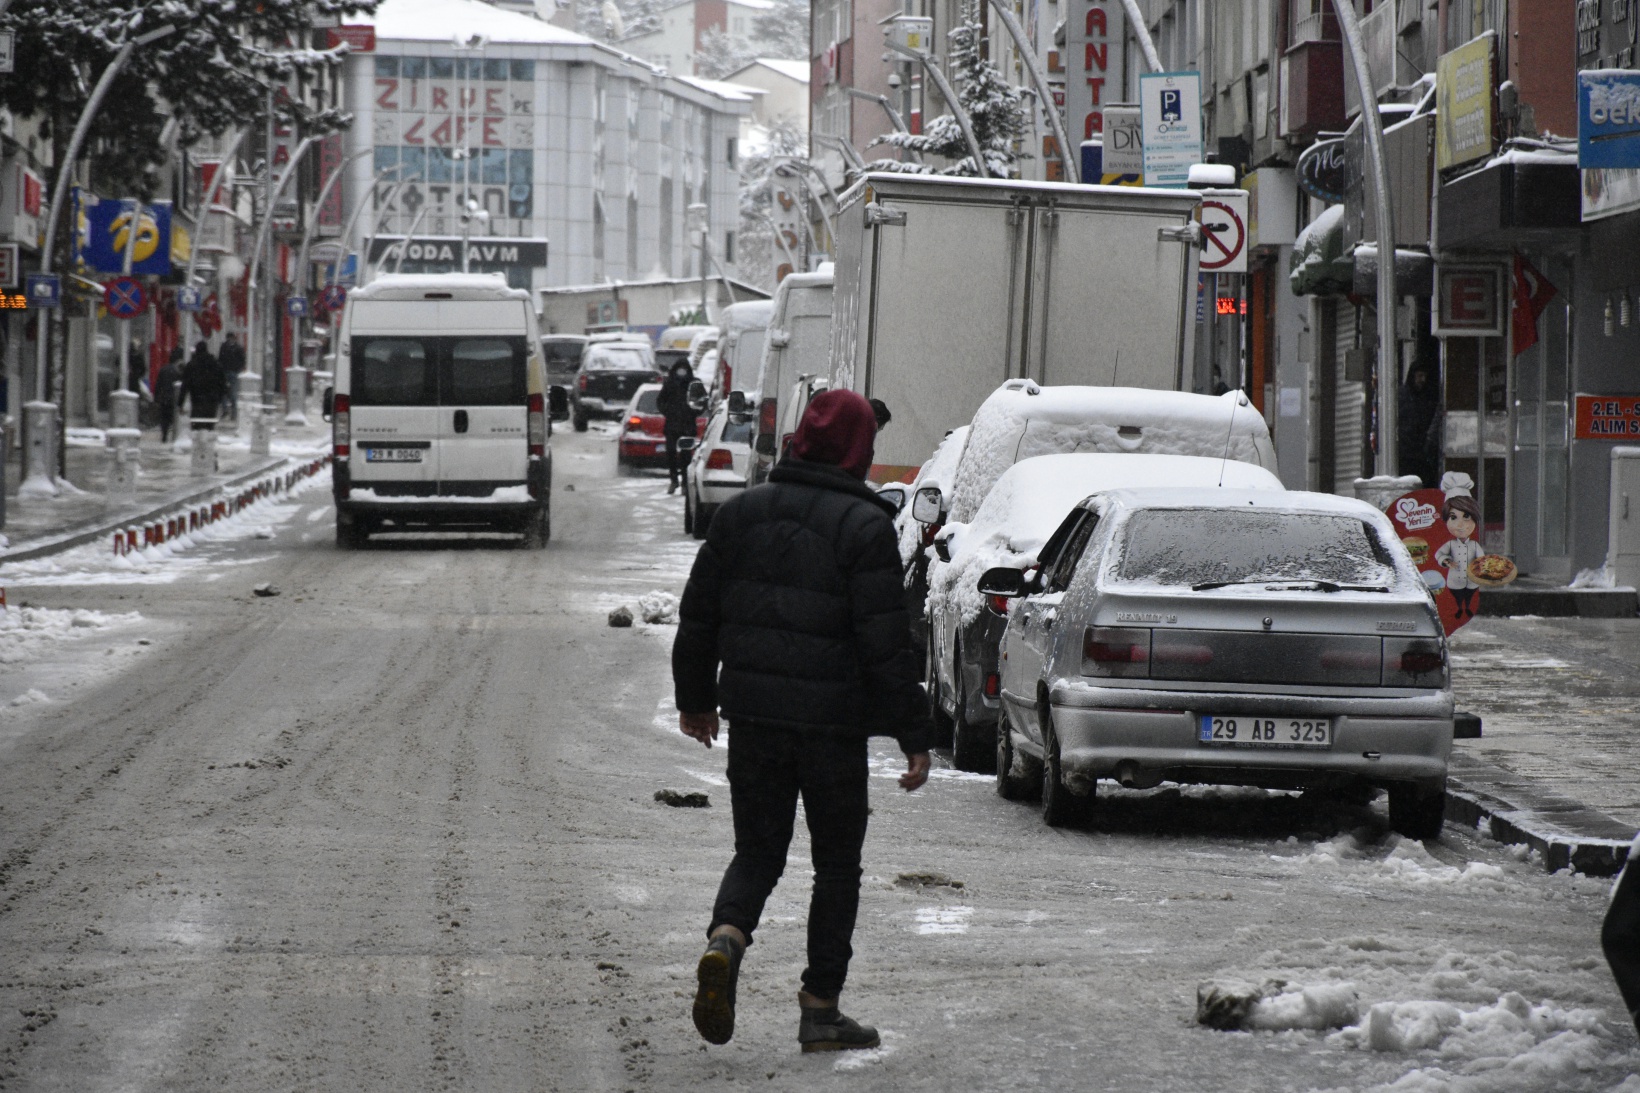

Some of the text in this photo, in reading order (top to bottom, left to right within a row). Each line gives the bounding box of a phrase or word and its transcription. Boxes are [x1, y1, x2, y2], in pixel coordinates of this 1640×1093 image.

[1164, 91, 1177, 109] P
[391, 246, 519, 262] MODA AVM
[1592, 401, 1623, 416] 2.EL
[1590, 419, 1640, 434] ALIM S
[1213, 718, 1237, 739] 29
[1252, 720, 1276, 740] AB
[1290, 721, 1327, 742] 325
